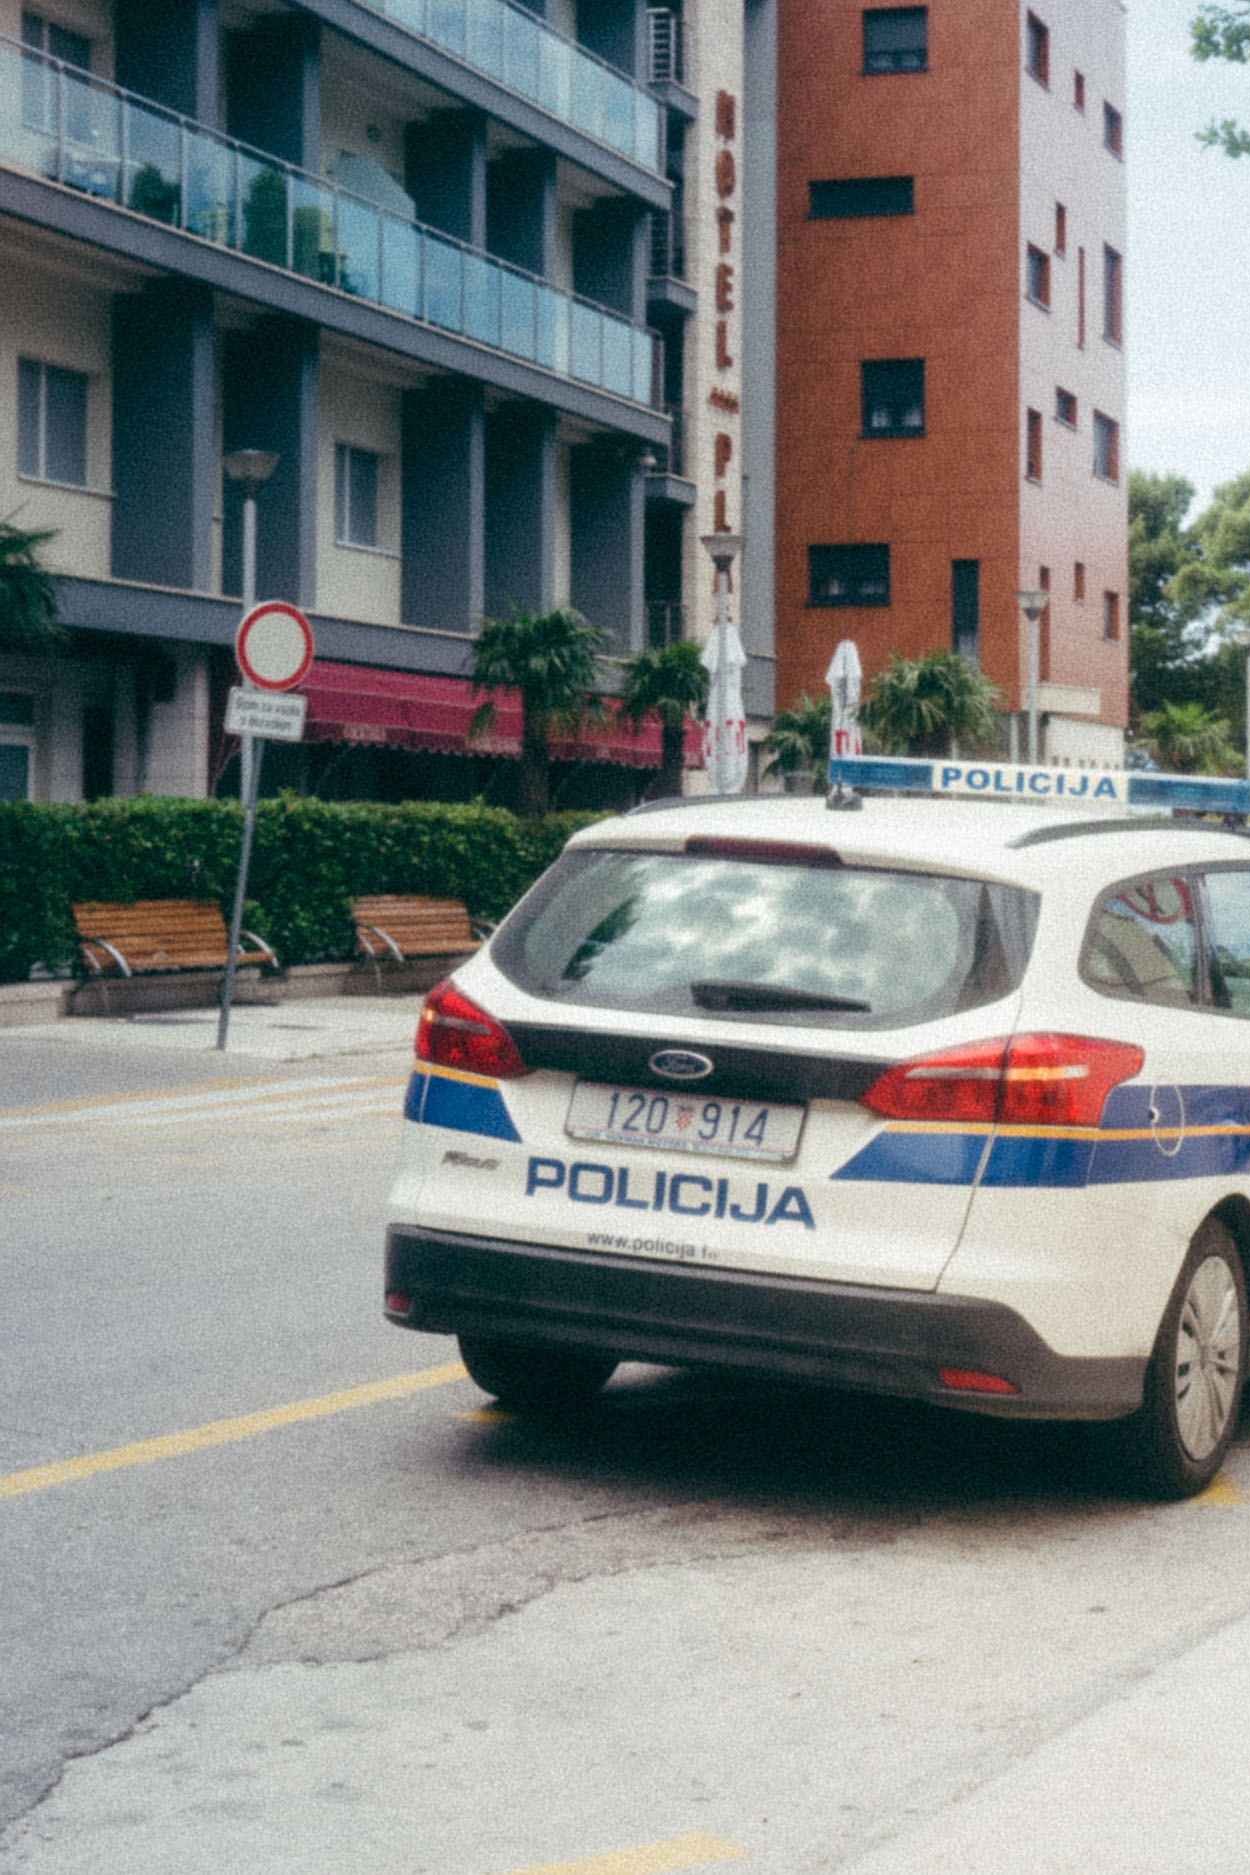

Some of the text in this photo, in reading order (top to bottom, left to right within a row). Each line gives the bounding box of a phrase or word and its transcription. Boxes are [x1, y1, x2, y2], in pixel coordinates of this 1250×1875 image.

[715, 89, 736, 371] HOTEL
[940, 767, 1118, 800] POLICIJA
[607, 1091, 670, 1135] 120
[697, 1101, 770, 1146] 914
[525, 1155, 817, 1231] POLICIJA
